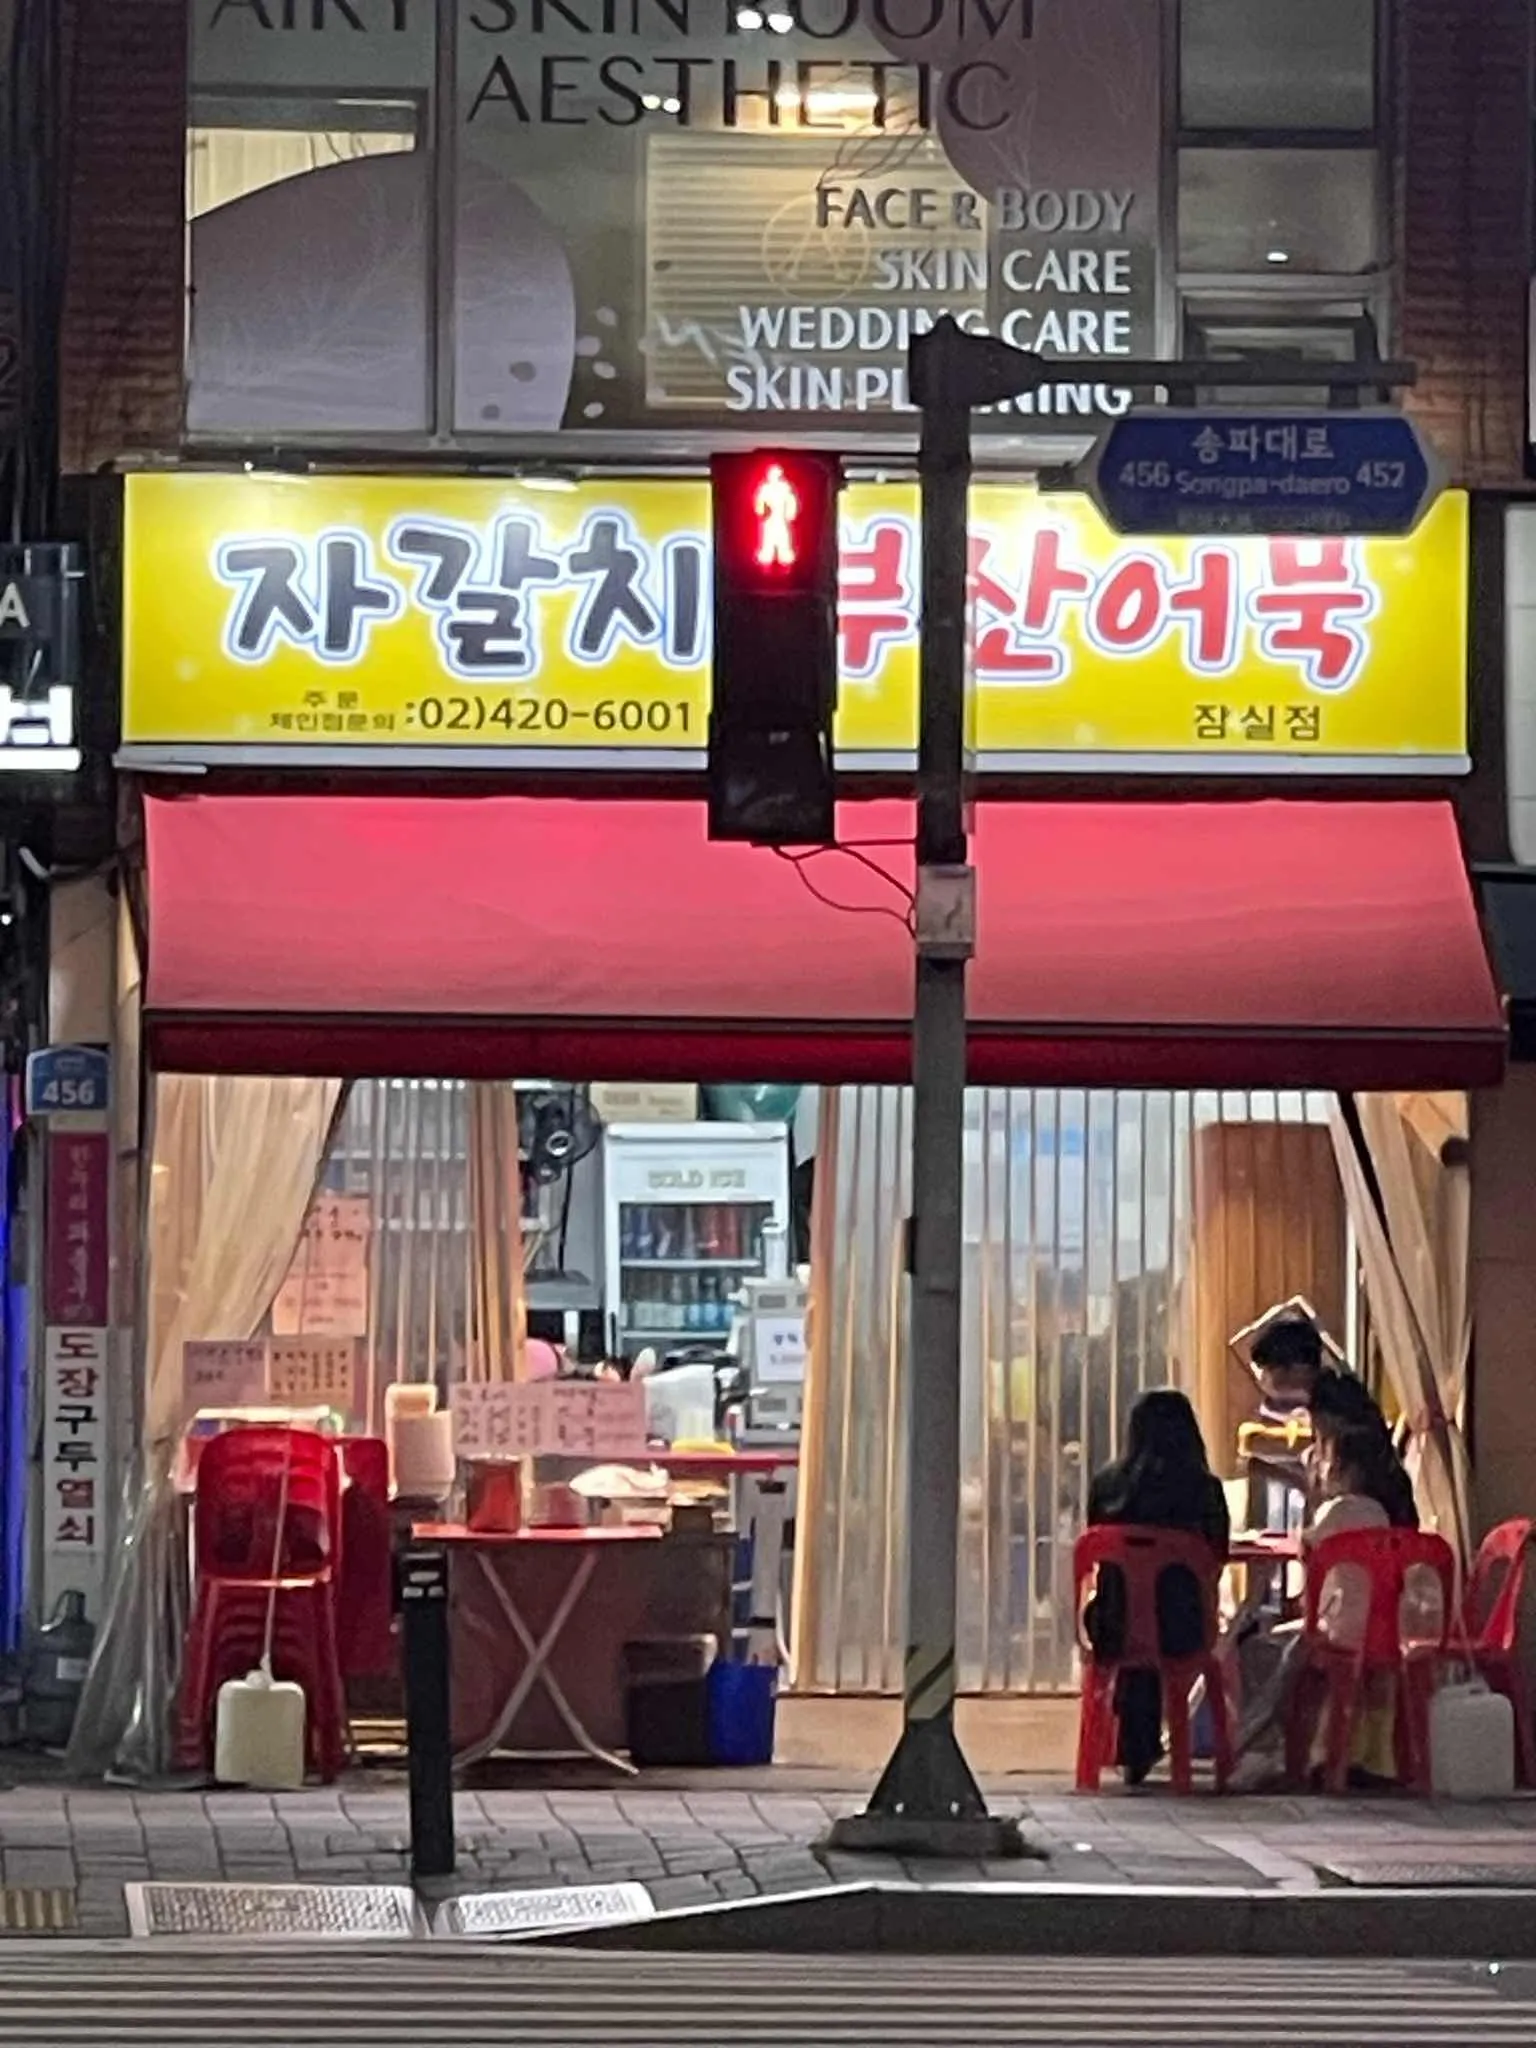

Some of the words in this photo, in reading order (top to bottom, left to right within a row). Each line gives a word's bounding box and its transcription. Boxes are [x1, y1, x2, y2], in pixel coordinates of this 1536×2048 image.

[466, 54, 1011, 130] AESTHETIC
[815, 187, 937, 229] FACE
[951, 190, 981, 230] &
[998, 188, 1136, 233] BODY
[870, 248, 989, 291] SKIN
[1002, 248, 1132, 294] CARE
[1002, 308, 1132, 354] CARE
[726, 365, 842, 412] SKIN
[856, 366, 1133, 415] PLING
[1190, 424, 1335, 464] 송파대로
[1118, 461, 1171, 488] 456
[1174, 469, 1351, 499] Songpa-daero
[219, 512, 708, 672] 자갈치
[1195, 703, 1322, 741] 잠실점
[41, 1079, 96, 1105] 456
